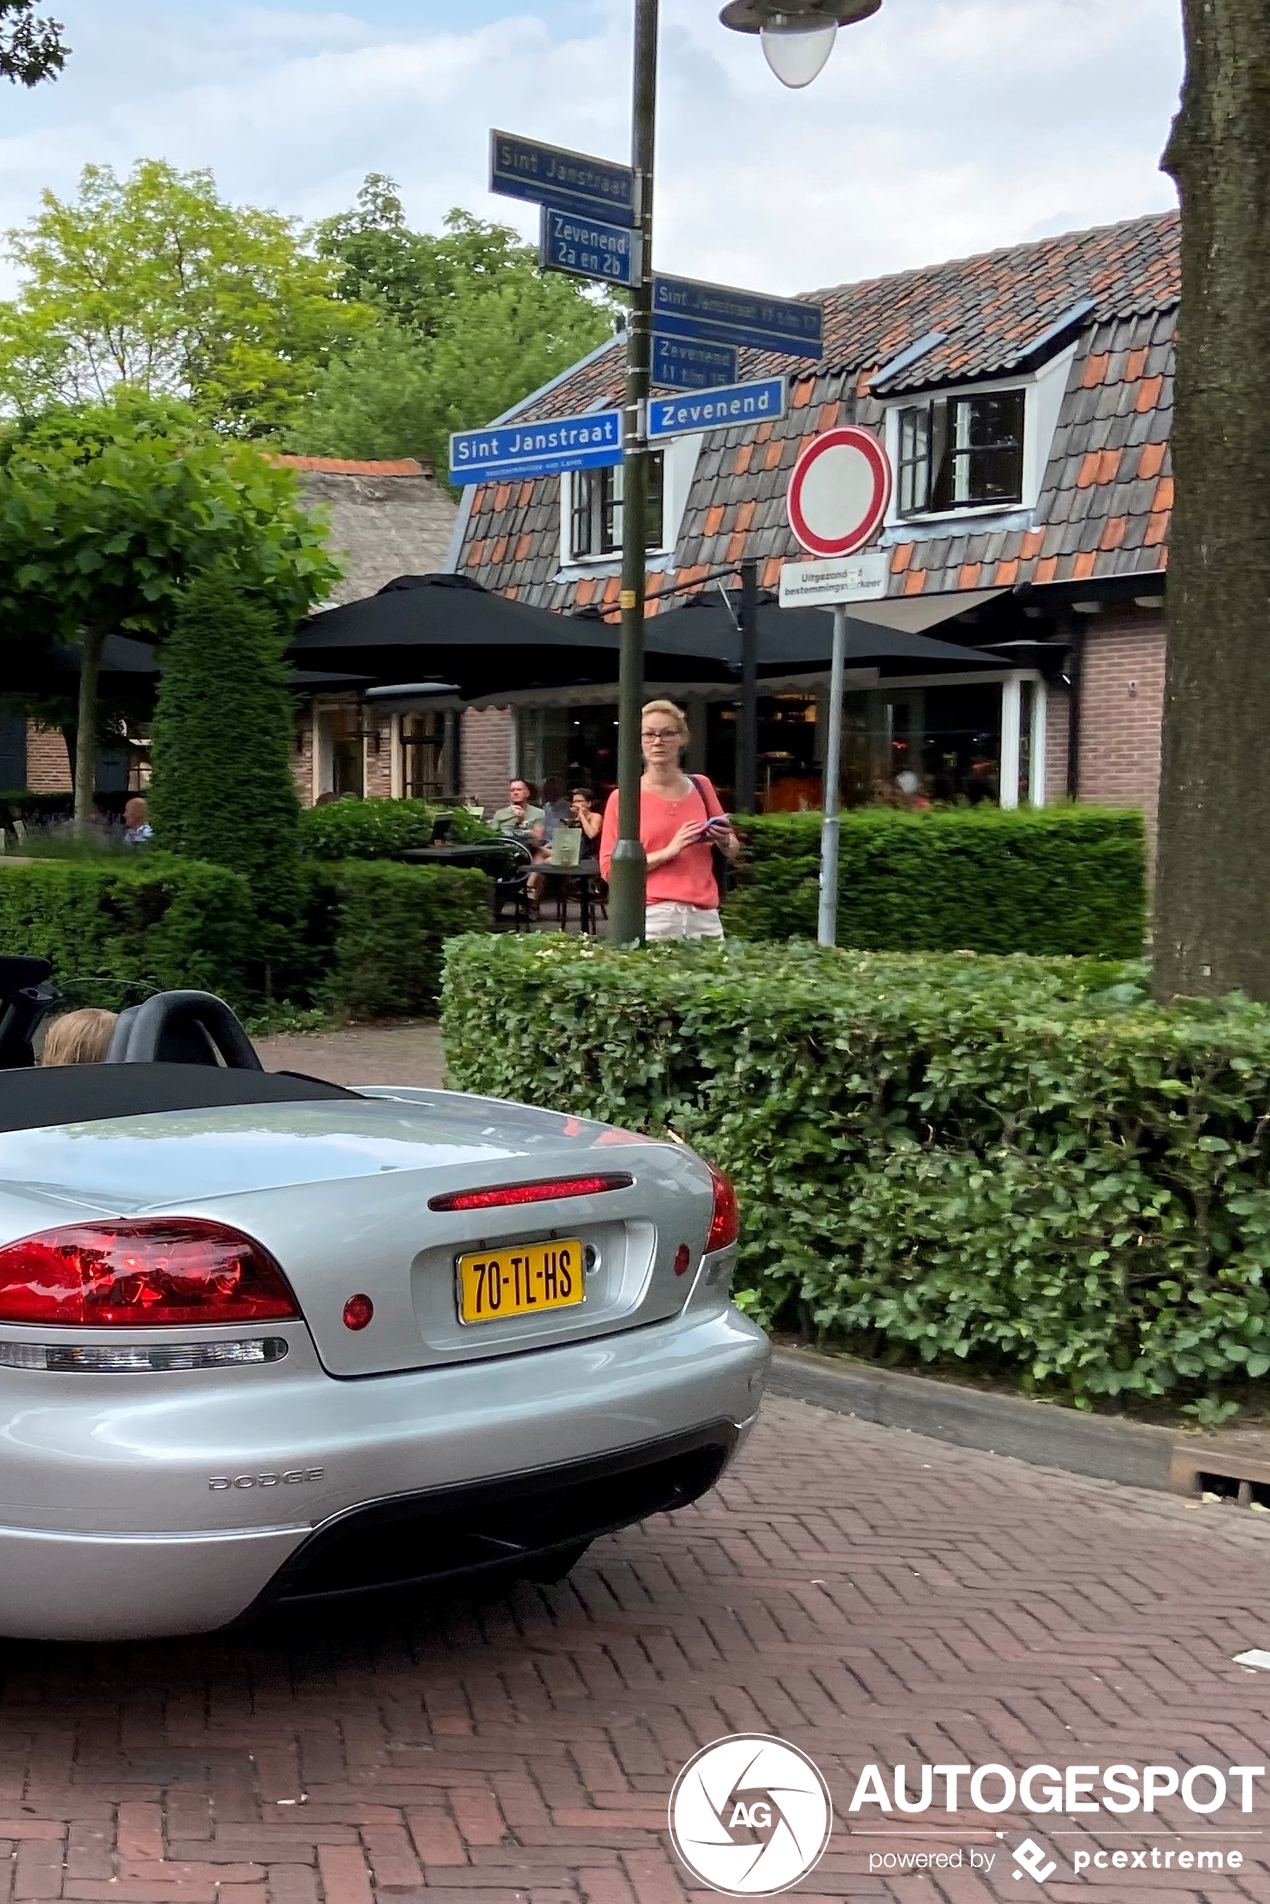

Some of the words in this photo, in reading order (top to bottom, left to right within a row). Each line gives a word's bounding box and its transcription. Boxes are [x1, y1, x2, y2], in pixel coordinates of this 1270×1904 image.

[502, 146, 538, 172] Sint
[546, 157, 628, 197] Janstraat
[554, 217, 626, 254] Zevenend
[558, 242, 576, 265] 2a
[581, 252, 598, 270] en
[603, 253, 621, 276] 2b
[661, 391, 770, 426] Zevenend
[458, 434, 499, 461] Sint
[509, 421, 613, 453] Janstraat
[801, 568, 863, 584] Uitgezondd
[473, 1250, 572, 1313] 70-TL-HS
[208, 1466, 324, 1491] DODGE
